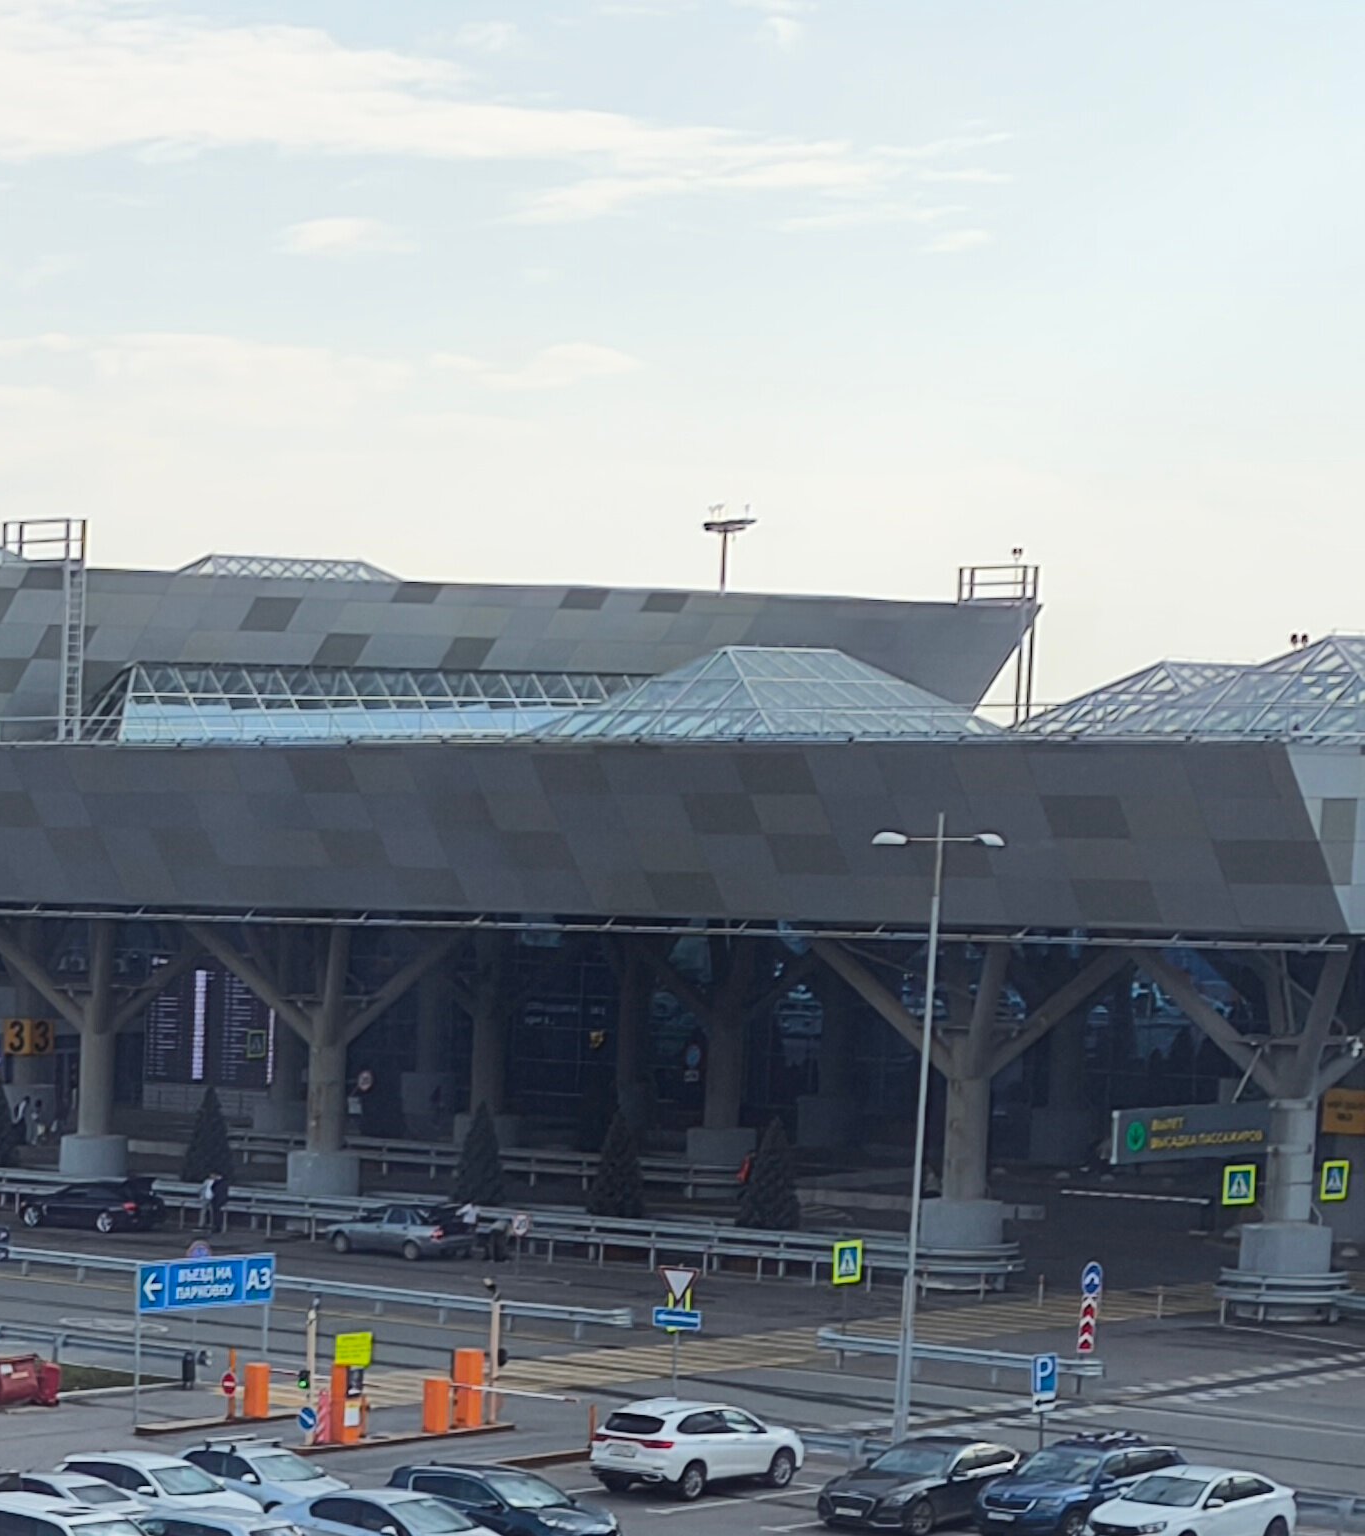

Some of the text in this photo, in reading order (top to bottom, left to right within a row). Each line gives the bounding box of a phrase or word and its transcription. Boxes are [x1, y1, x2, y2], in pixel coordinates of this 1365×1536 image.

[9, 1020, 25, 1053] 3
[34, 1020, 50, 1053] 3
[177, 1265, 233, 1283] ВЪЕЗД НА
